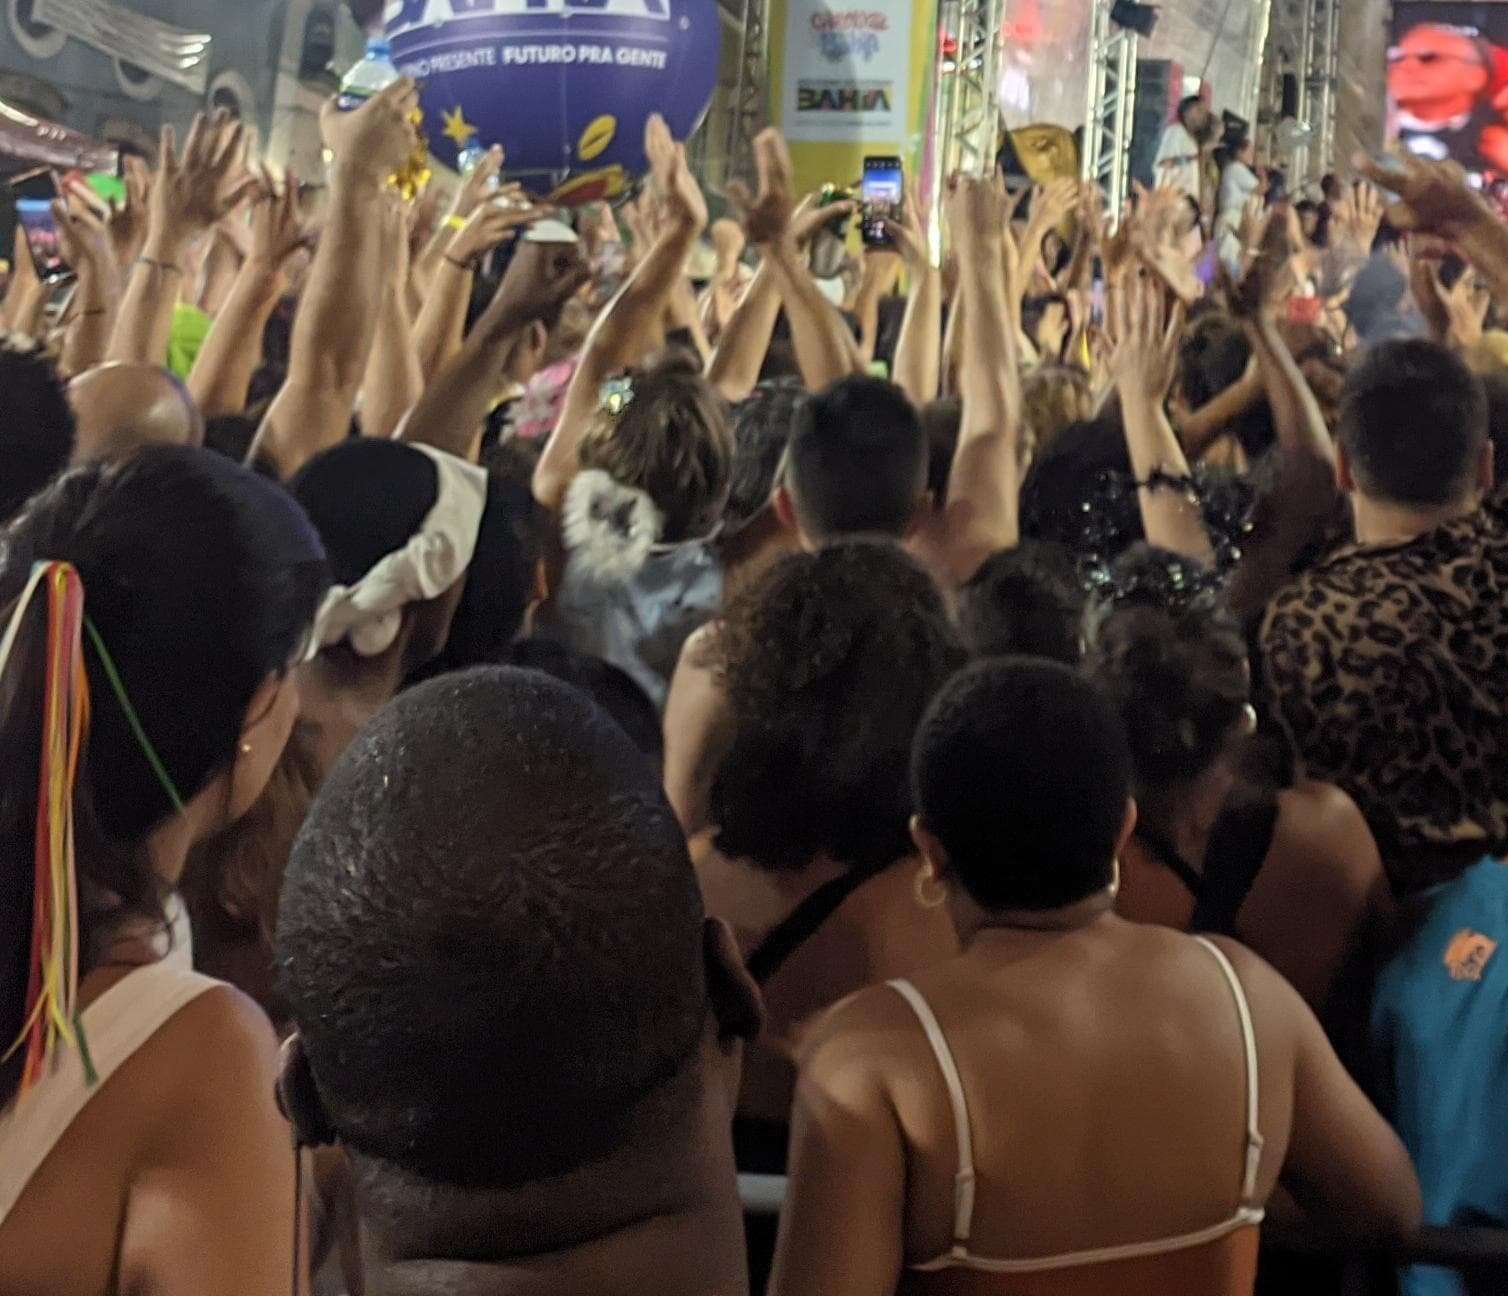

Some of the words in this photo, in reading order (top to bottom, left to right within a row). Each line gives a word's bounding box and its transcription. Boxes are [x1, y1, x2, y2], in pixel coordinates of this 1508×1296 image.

[431, 48, 497, 74] PRESENTE
[502, 44, 577, 65] FUTURO
[578, 45, 614, 65] PRA
[615, 46, 668, 70] GENTE
